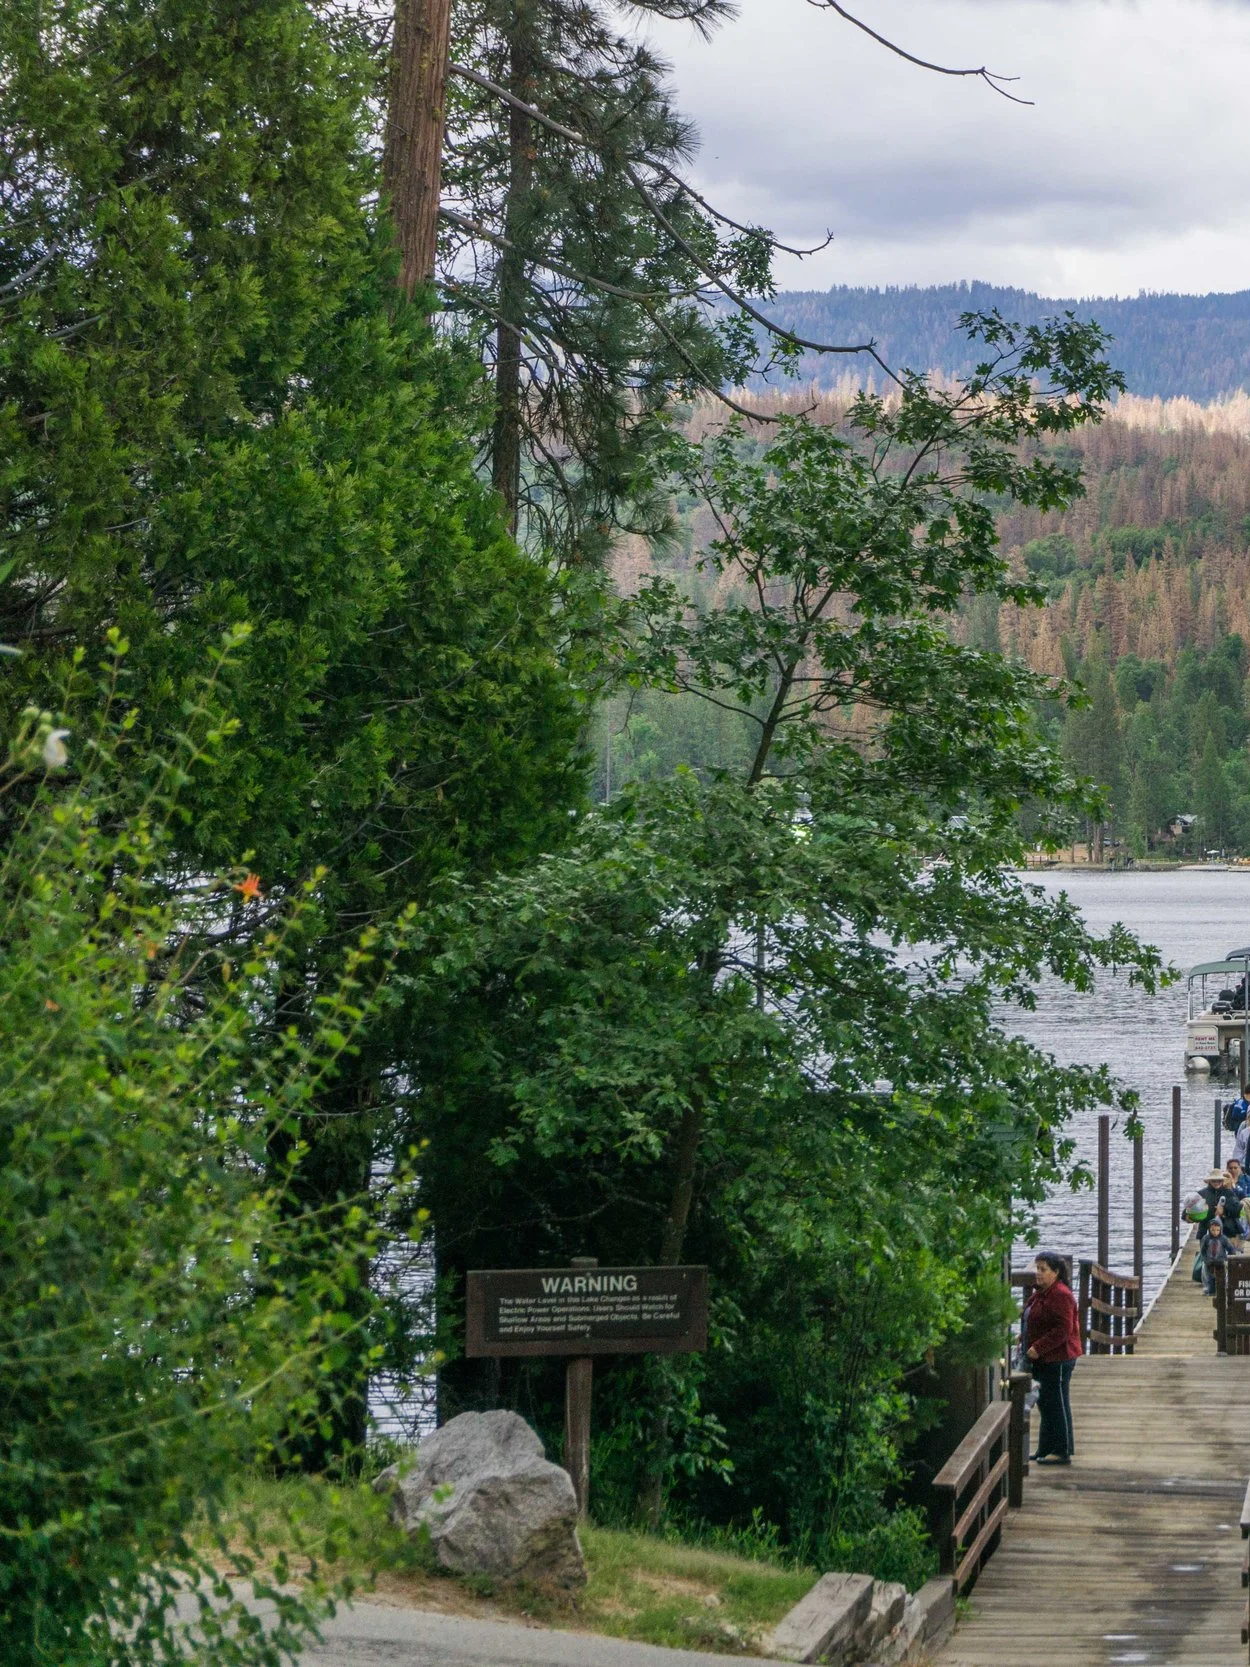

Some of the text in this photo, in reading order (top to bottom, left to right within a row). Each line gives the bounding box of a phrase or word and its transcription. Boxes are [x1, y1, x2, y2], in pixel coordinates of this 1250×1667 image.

[541, 1274, 638, 1293] WARNING
[600, 1295, 631, 1303] Changes
[569, 1314, 609, 1323] Submerged
[514, 1325, 535, 1334] Enjoy
